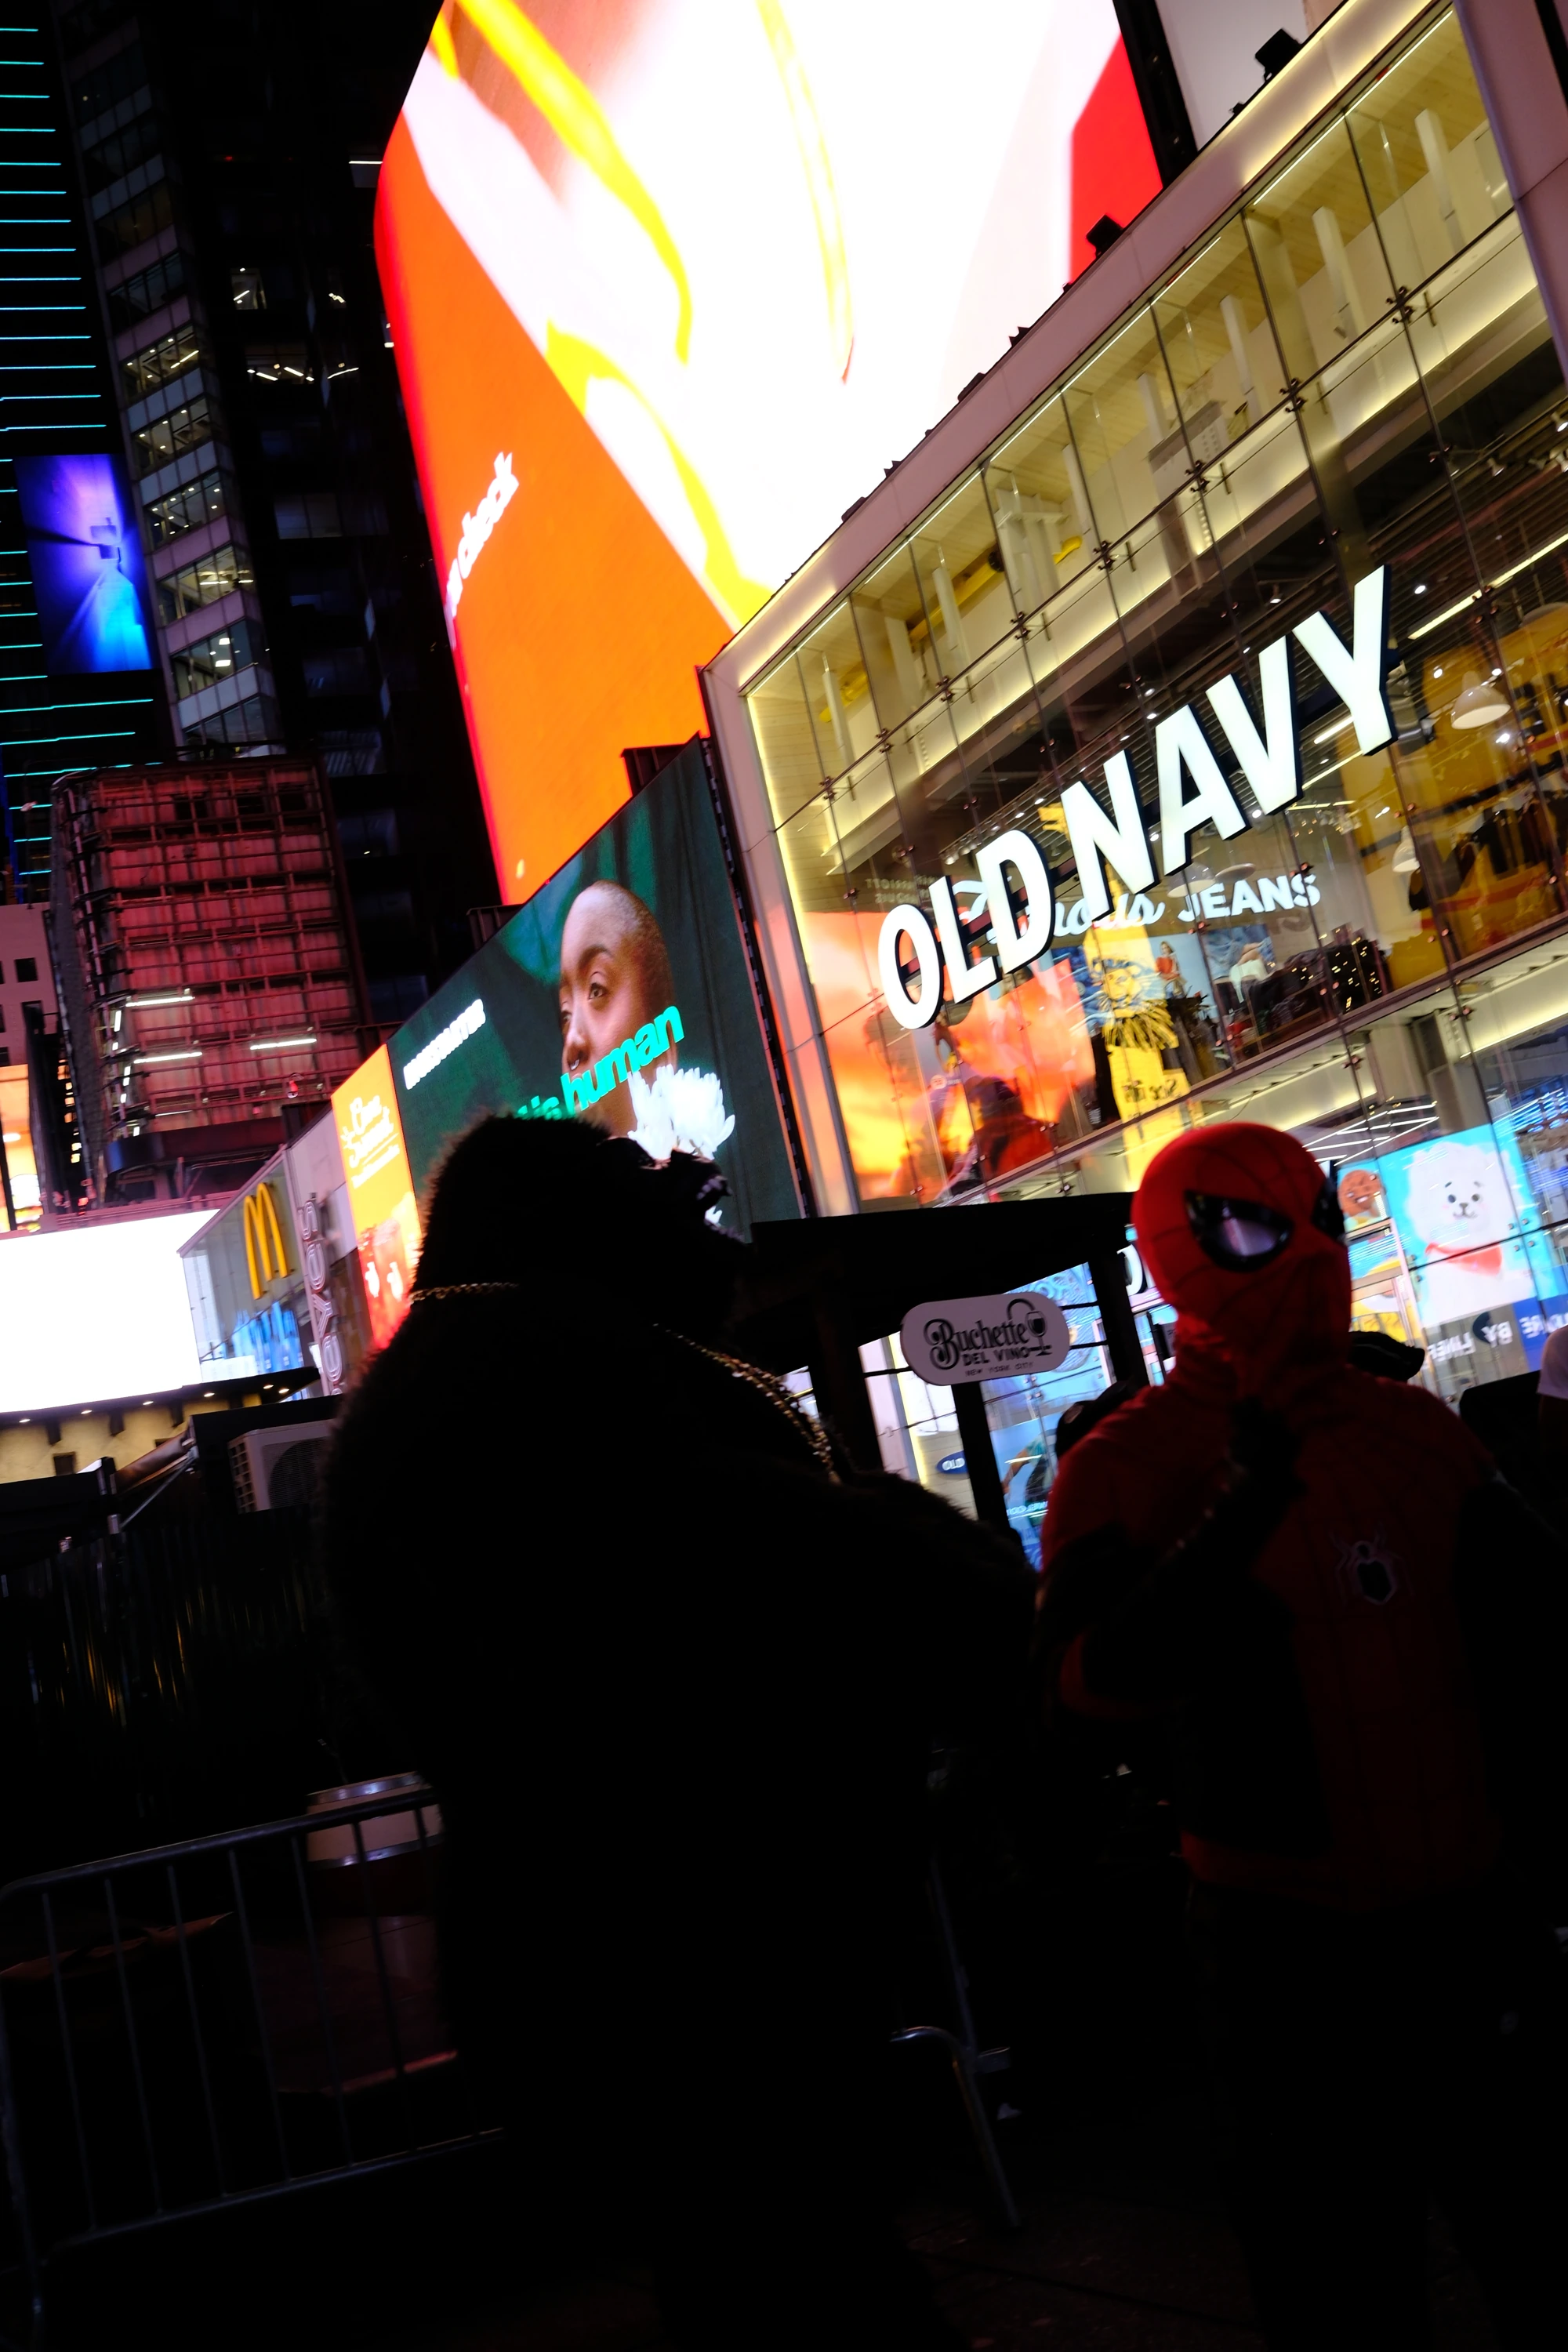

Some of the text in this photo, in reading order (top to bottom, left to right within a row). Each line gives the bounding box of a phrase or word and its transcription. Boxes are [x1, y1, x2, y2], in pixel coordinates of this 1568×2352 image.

[878, 564, 1398, 1031] OLD NAVY
[1178, 873, 1321, 923] JEANS
[560, 1005, 684, 1116] human
[924, 1318, 1029, 1370] Buchette
[962, 1346, 1029, 1366] DEL VINO
[965, 1368, 983, 1377] NEW
